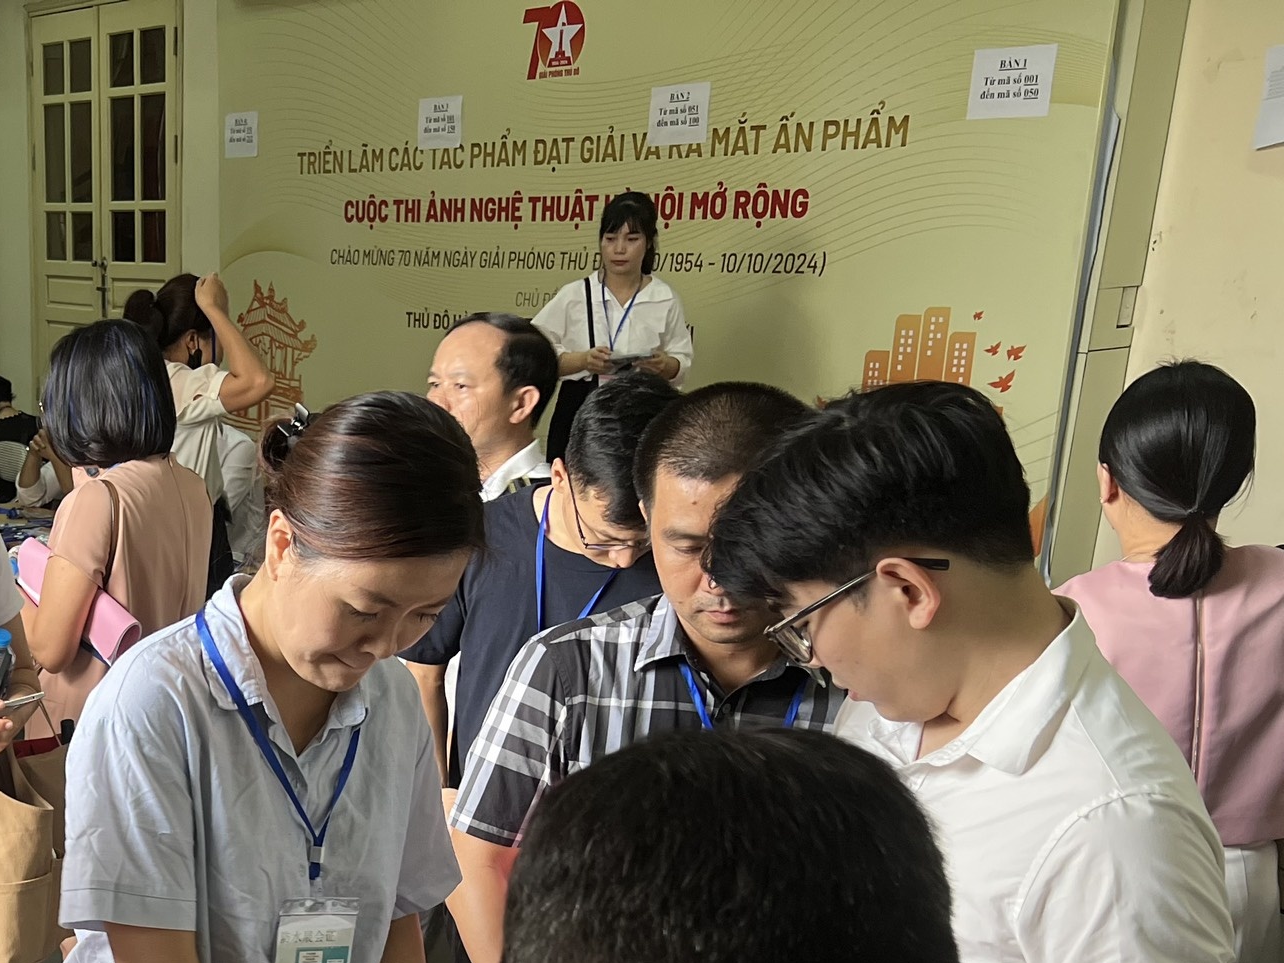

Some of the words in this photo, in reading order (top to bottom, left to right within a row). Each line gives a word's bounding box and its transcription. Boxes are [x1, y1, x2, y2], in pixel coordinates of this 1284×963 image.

[984, 76, 997, 86] Từ
[997, 76, 1011, 85] mã
[1013, 73, 1022, 84] số
[1024, 75, 1039, 84] 001
[980, 88, 995, 99] đến
[997, 90, 1011, 98] mã
[1013, 86, 1022, 97] số
[1023, 88, 1039, 97] 050
[297, 139, 344, 175] TRIỂN
[347, 142, 384, 173] LÃM
[388, 140, 424, 172] CÁC
[470, 127, 527, 168] PHẨM
[533, 136, 575, 173] ĐẠT
[580, 125, 626, 164] GIẢI
[710, 111, 767, 157] MẮT
[772, 111, 815, 155] ẤN
[821, 99, 910, 152] PHẨM
[344, 194, 388, 230] CUỘC
[393, 199, 421, 223] THI
[425, 190, 465, 223] ẢNH
[470, 190, 523, 230] NGHỆ
[528, 188, 599, 230] THUẬT
[689, 182, 728, 220] MỞ
[732, 182, 810, 228] RỘNG
[330, 245, 360, 266] CHÀO
[362, 246, 395, 267] MỪNG
[398, 250, 412, 267] 70
[414, 246, 441, 268] NĂM
[443, 246, 478, 269] NGÀY
[479, 245, 505, 269] GIẢI
[507, 246, 555, 271] PHÓNG
[559, 246, 589, 271] THỦ
[720, 251, 827, 277] 10/10/2024)
[515, 287, 542, 308] CHỦ
[405, 307, 430, 330] THỦ
[433, 309, 451, 330] ĐÔ
